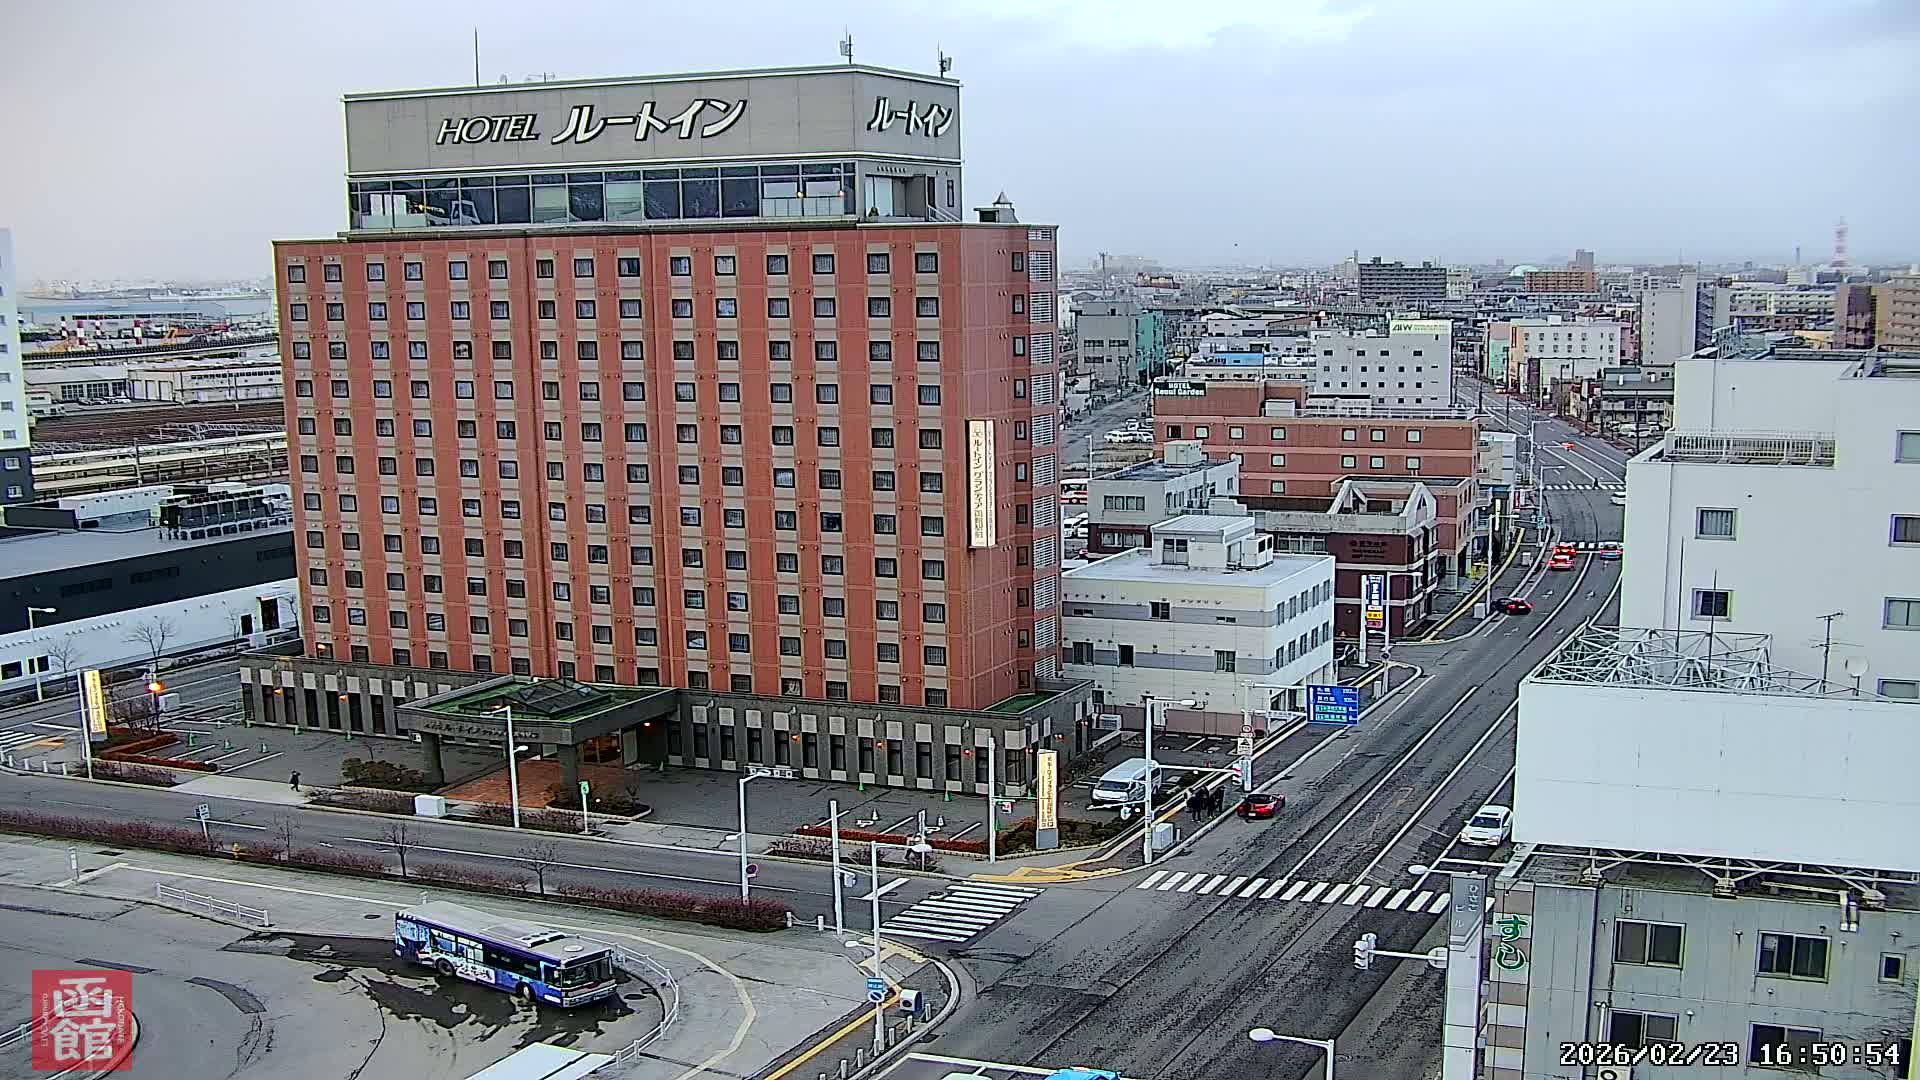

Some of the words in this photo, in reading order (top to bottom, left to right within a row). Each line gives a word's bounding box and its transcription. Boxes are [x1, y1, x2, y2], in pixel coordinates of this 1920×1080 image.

[436, 113, 541, 144] HOTEL
[550, 98, 747, 146] ルートイン
[866, 95, 953, 137] ルートイン
[1154, 388, 1177, 396] Seoul
[1177, 388, 1205, 396] Garden
